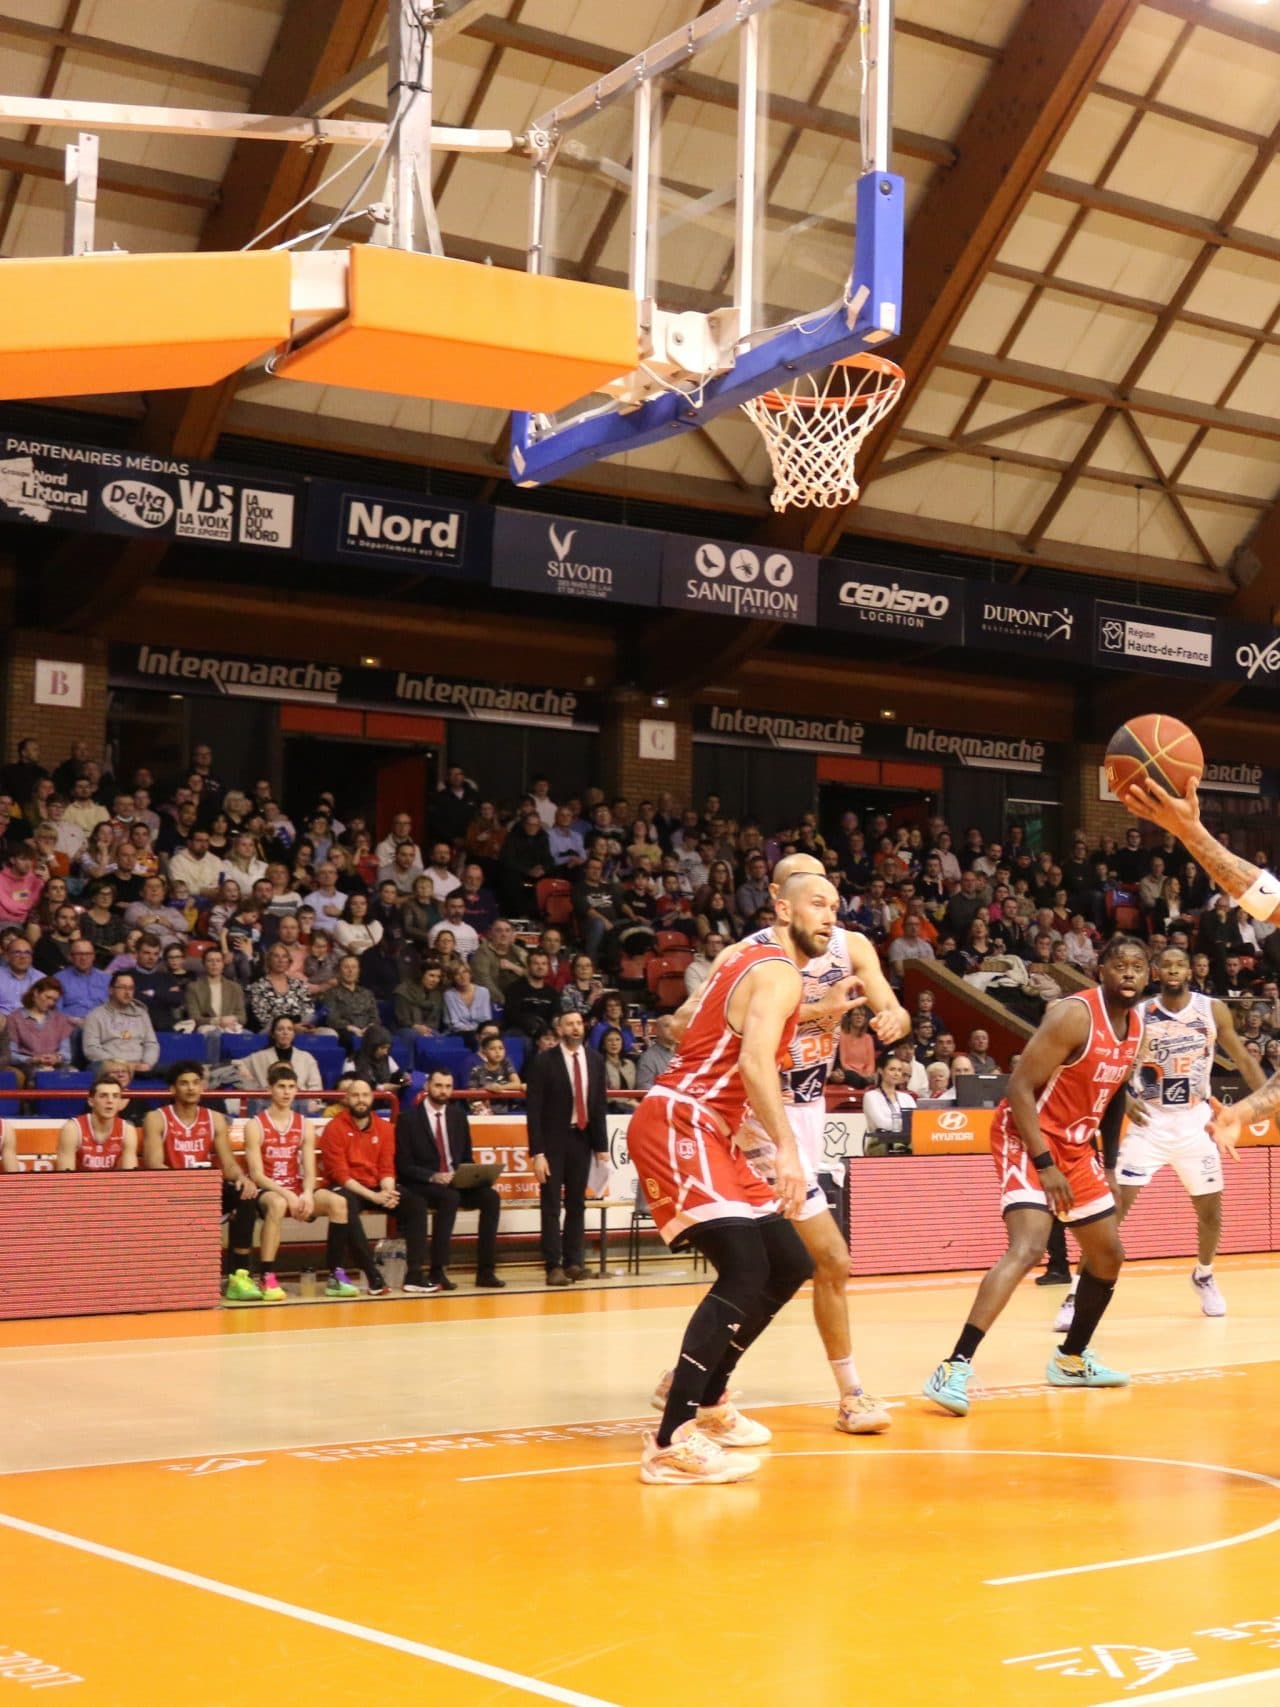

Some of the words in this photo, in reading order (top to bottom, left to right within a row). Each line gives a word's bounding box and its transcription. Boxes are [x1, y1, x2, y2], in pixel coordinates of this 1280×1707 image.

[6, 438, 122, 467] PARTENAIRES
[125, 456, 190, 476] MÉDIAS
[33, 470, 68, 486] Nord
[110, 484, 166, 509] Delta
[178, 479, 234, 516] VDS
[247, 494, 258, 506] LA
[179, 512, 194, 525] LA
[199, 513, 229, 530] VOIX
[246, 506, 273, 519] VOIX
[247, 517, 262, 530] DU
[348, 501, 460, 549] Nord
[245, 530, 279, 543] NORD
[687, 579, 798, 614] SANITATION
[983, 604, 1053, 627] DUPONT
[1127, 640, 1209, 662] Hauts-de-France
[137, 645, 342, 693] Intermarché
[50, 670, 69, 696] B
[396, 672, 577, 716] Intermarché
[651, 728, 666, 750] C
[711, 706, 864, 747] Intermarché
[906, 727, 1045, 764] Intermarché
[800, 1033, 833, 1063] 20
